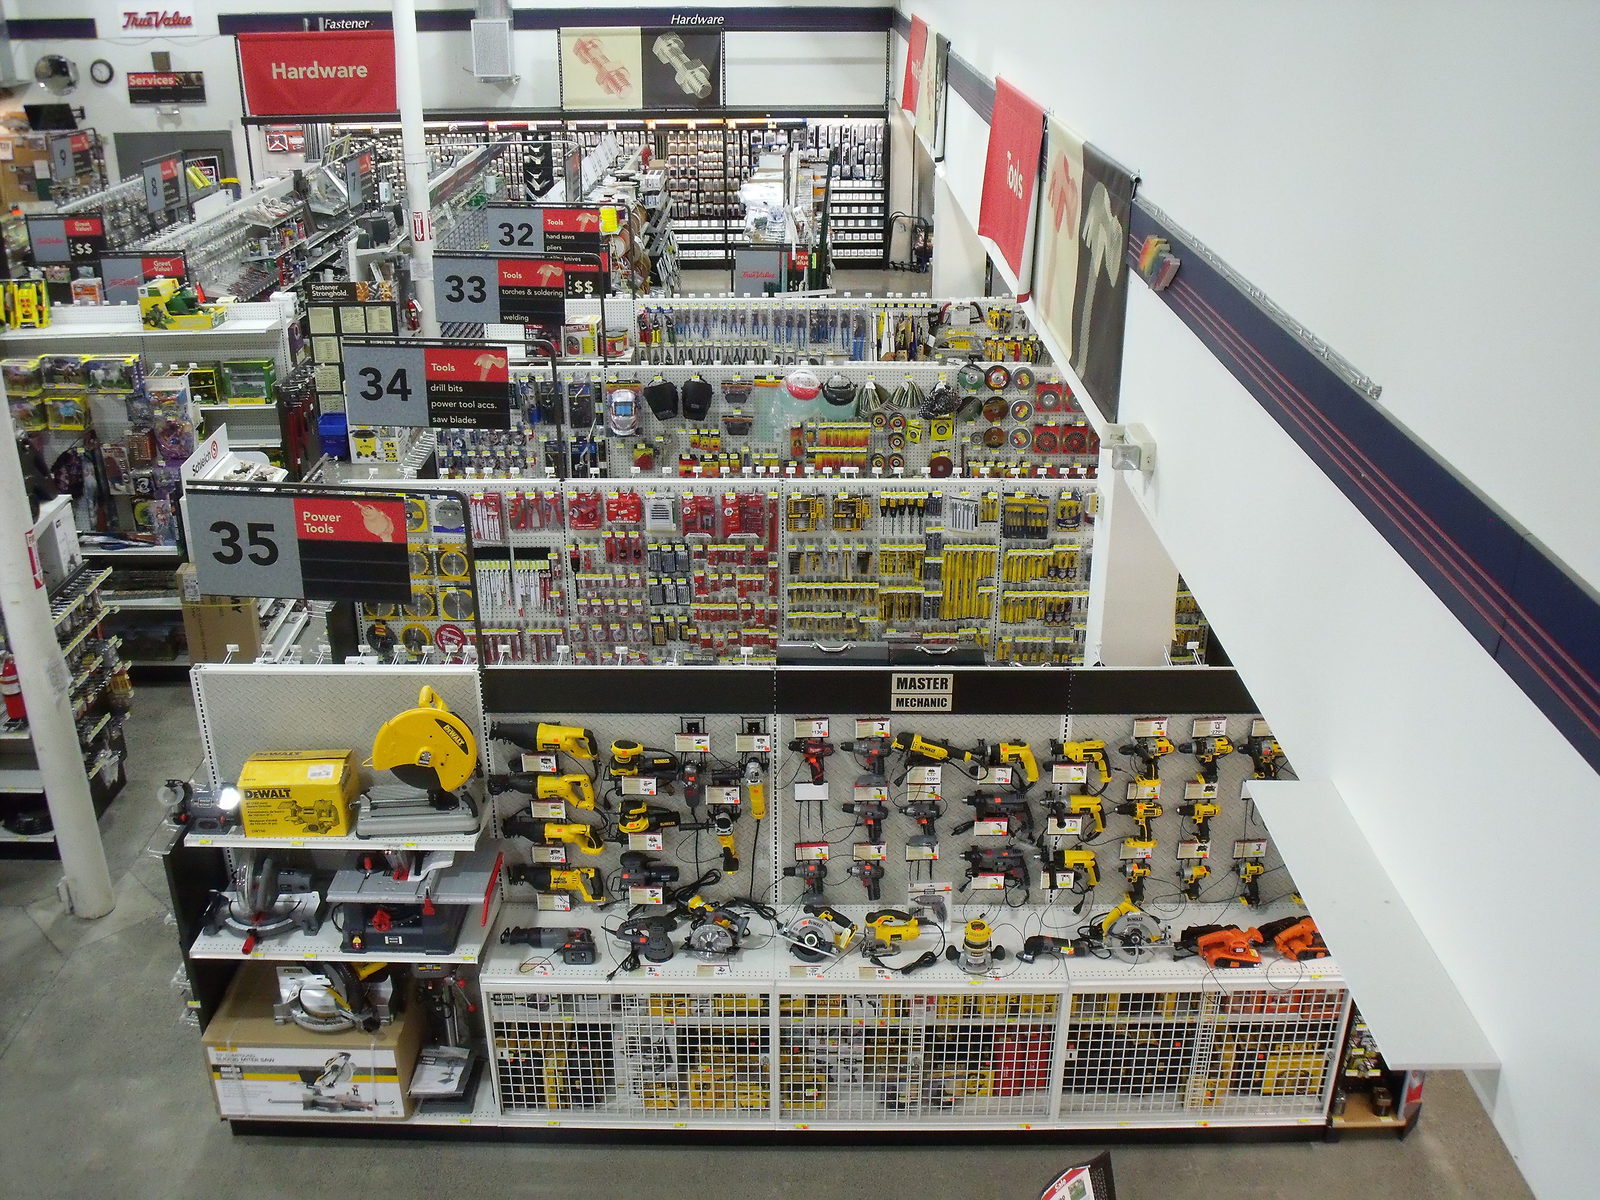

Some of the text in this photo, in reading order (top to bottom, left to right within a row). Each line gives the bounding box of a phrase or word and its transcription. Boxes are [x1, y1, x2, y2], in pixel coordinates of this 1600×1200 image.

[324, 18, 370, 29] Fastener
[670, 13, 725, 25] Hardware
[271, 60, 368, 80] Hardware
[128, 75, 174, 86] Services
[498, 222, 534, 247] 32
[546, 244, 562, 252] pliers
[503, 271, 523, 279] Tools
[445, 274, 487, 304] 33
[574, 279, 594, 294] $$
[534, 288, 563, 298] soldering
[503, 313, 530, 323] welding
[431, 362, 456, 372] Tools
[358, 366, 412, 402] 34
[430, 383, 464, 393] drill bits
[431, 401, 457, 410] power
[458, 400, 475, 408] tool
[449, 415, 477, 424] blades
[302, 511, 342, 523] Power
[303, 522, 335, 534] Tools
[209, 520, 279, 567] 35
[896, 676, 949, 690] MASTER
[895, 697, 948, 708] MECHANIC
